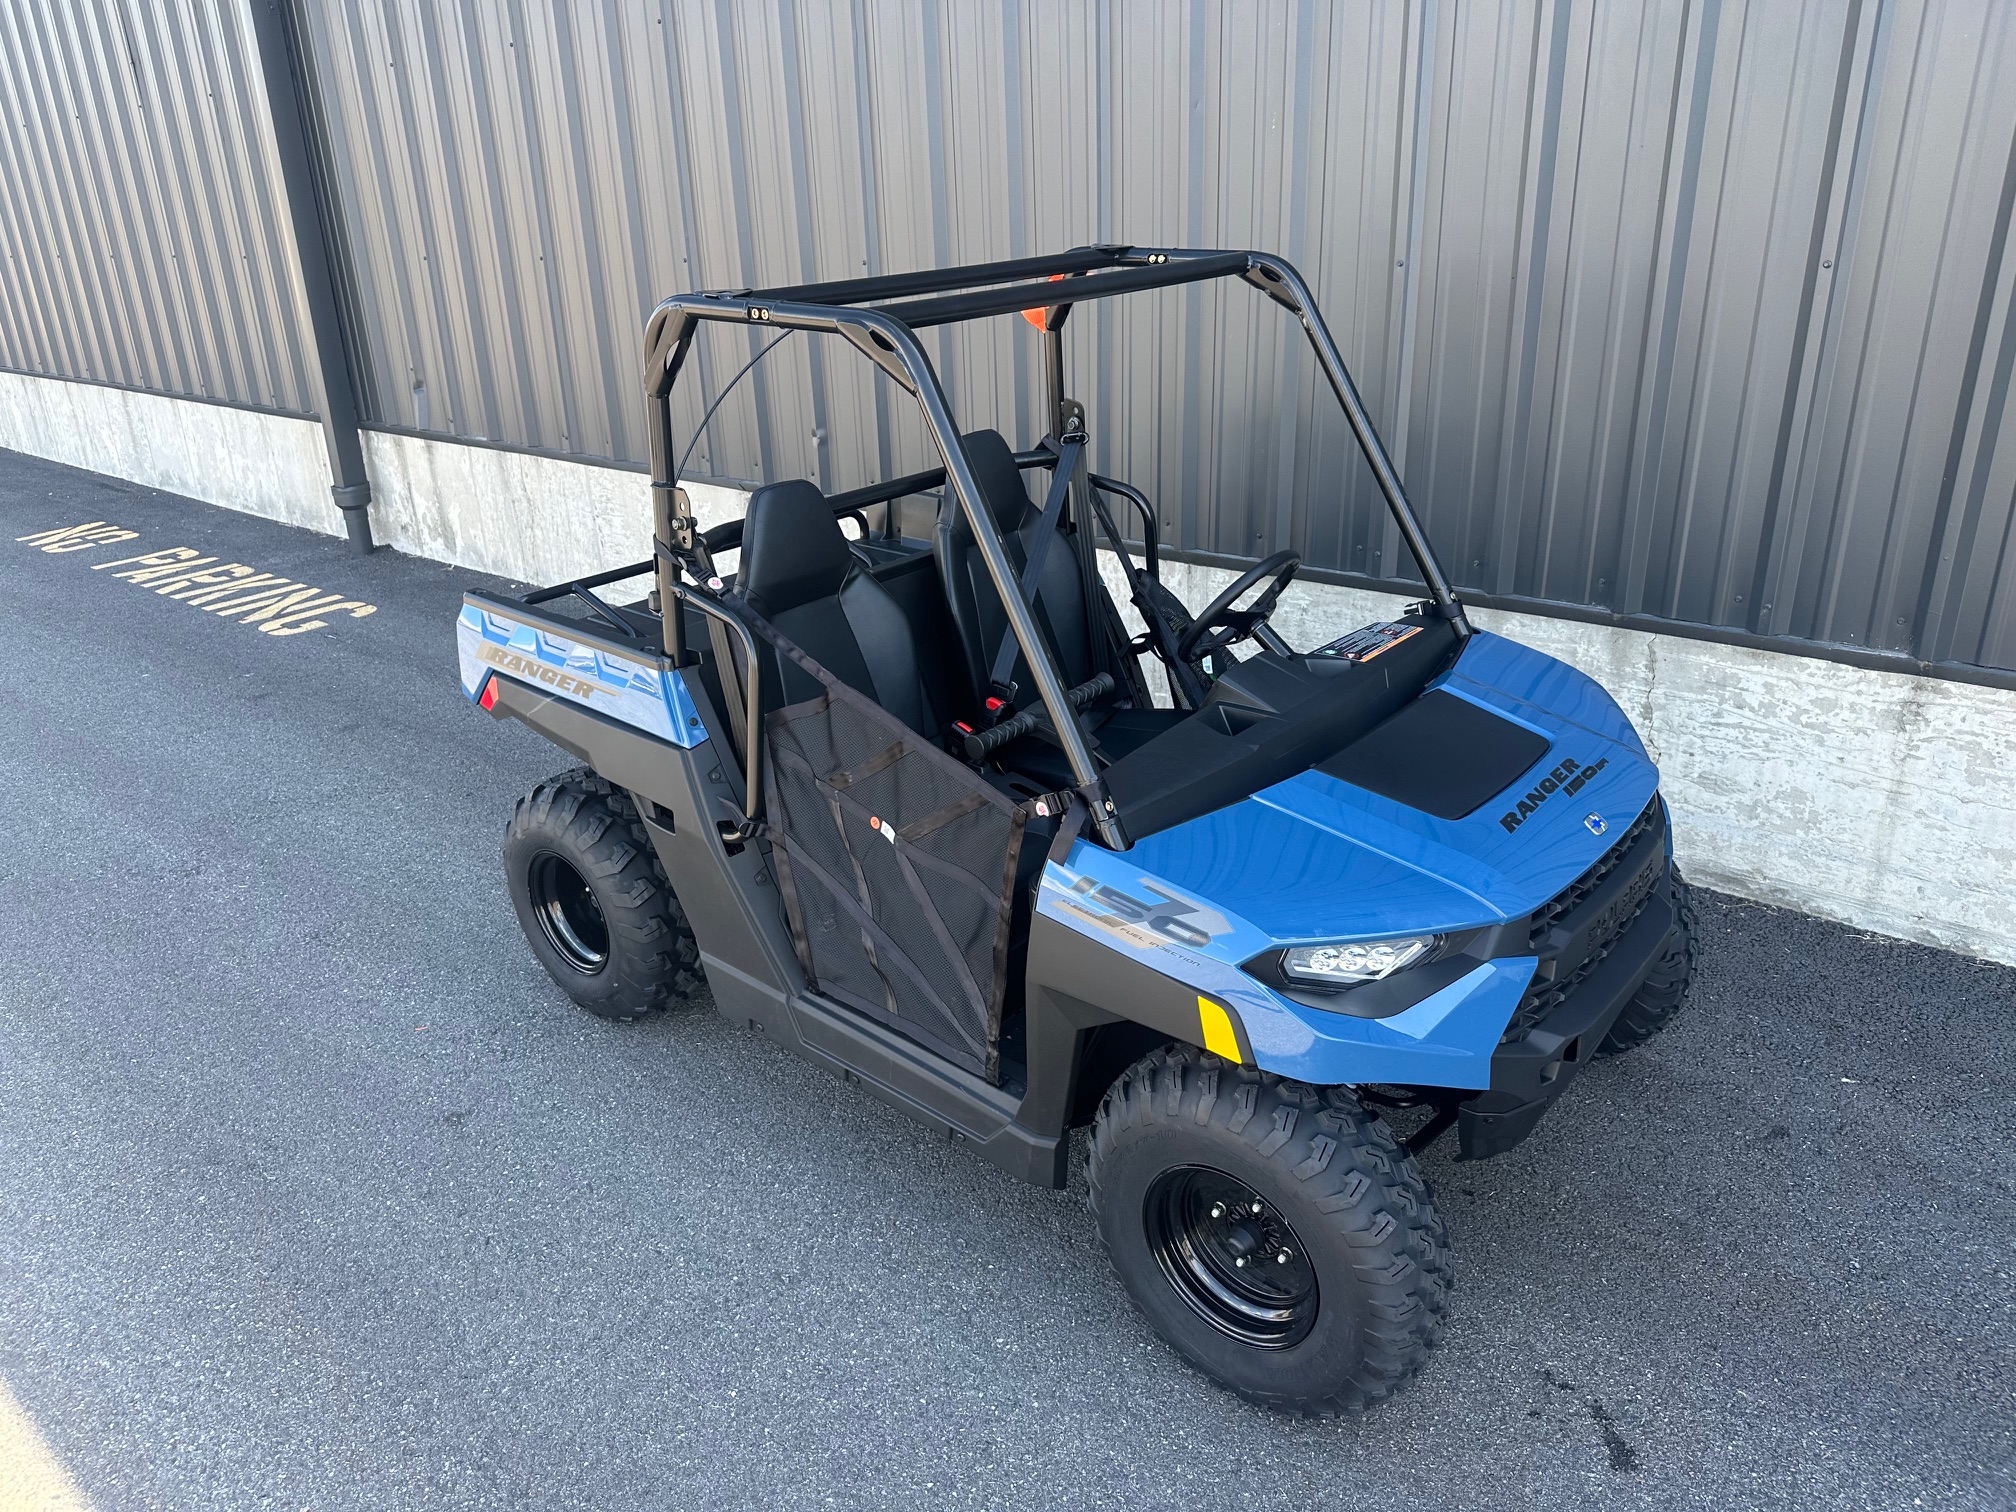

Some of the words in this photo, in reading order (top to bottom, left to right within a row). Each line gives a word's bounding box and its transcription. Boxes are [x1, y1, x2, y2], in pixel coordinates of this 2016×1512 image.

[15, 521, 140, 554] NO
[91, 546, 378, 636] PARKING
[488, 646, 596, 699] RANGER
[1499, 757, 1581, 834] RANGER
[1061, 898, 1118, 929] ELECTRONIC
[1119, 926, 1145, 943] FUEL
[1148, 940, 1201, 967] INJECTION
[1069, 875, 1212, 949] 150
